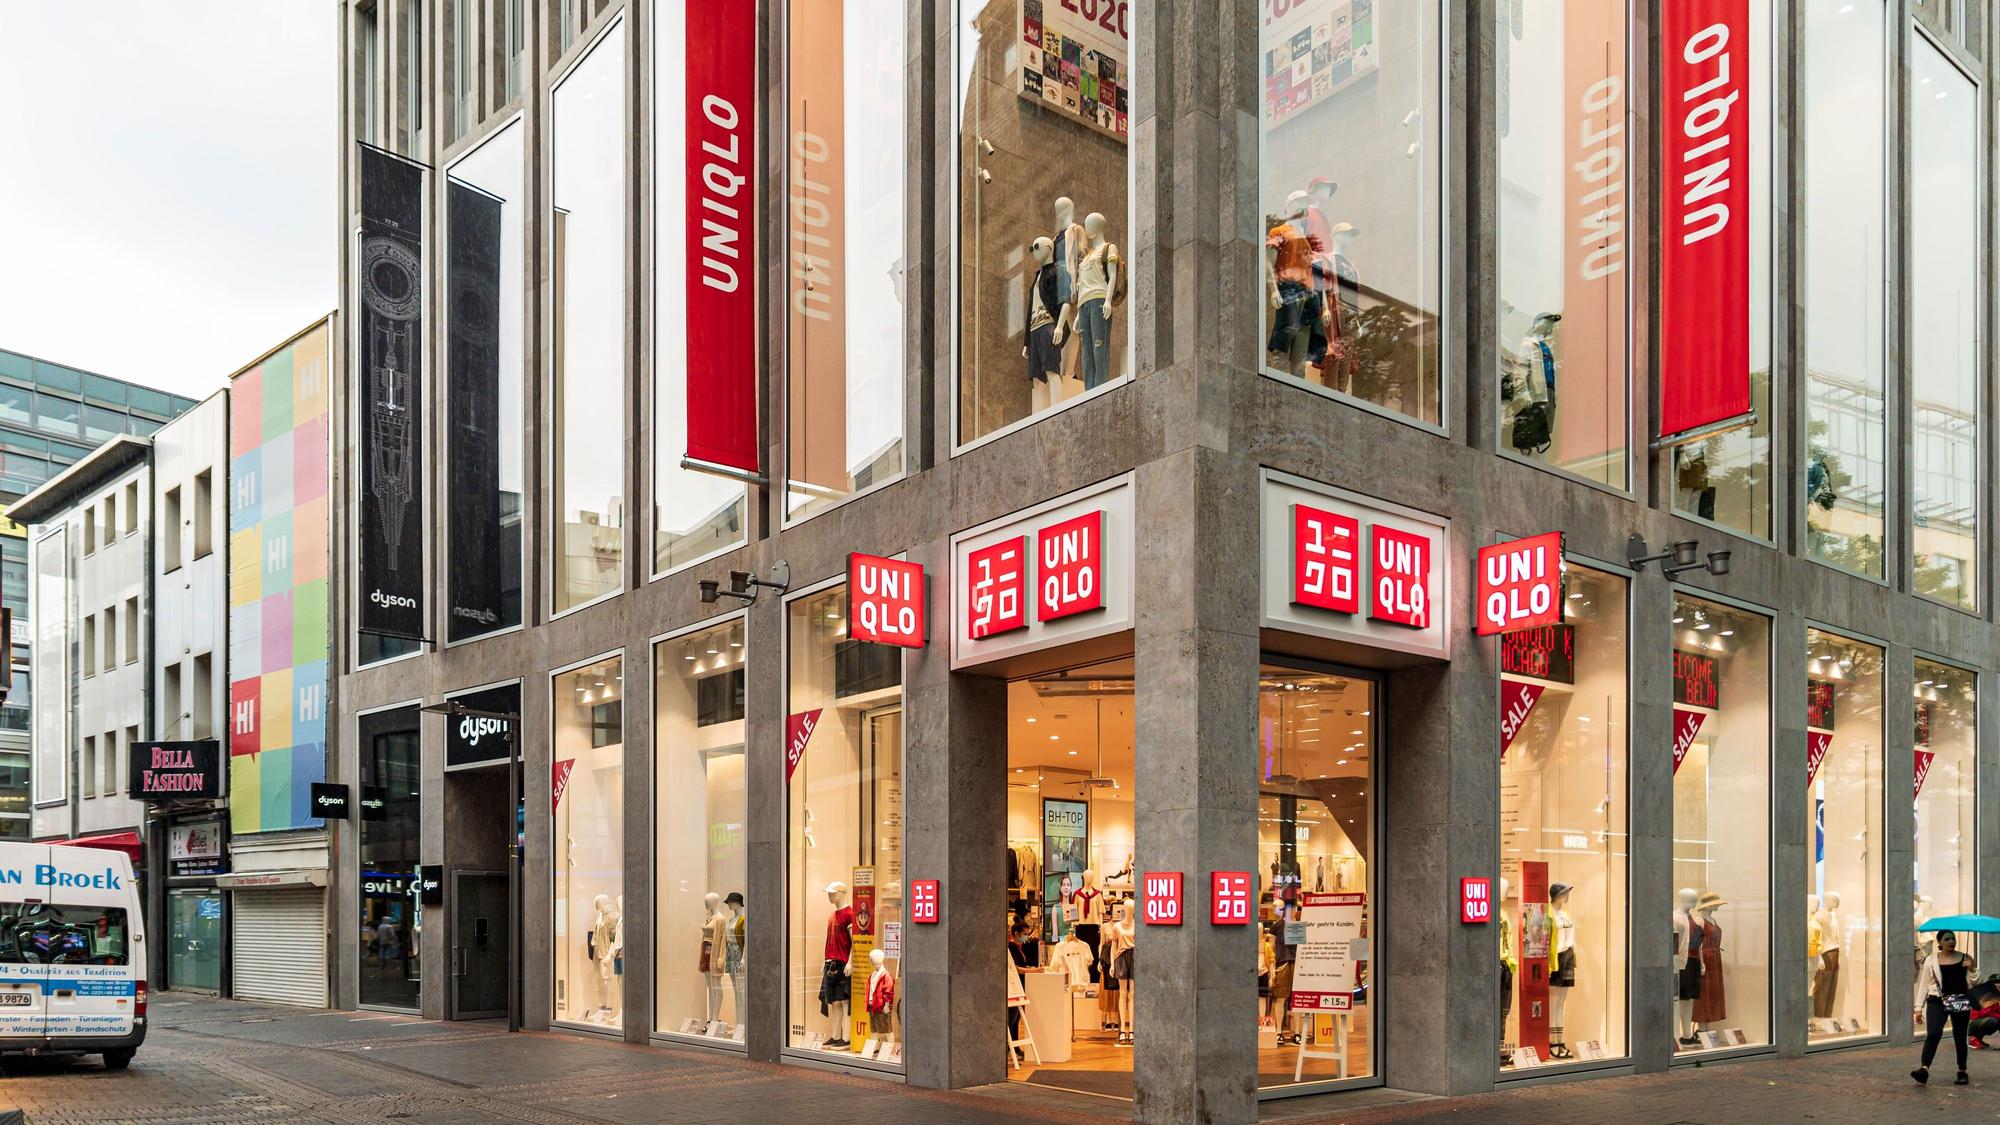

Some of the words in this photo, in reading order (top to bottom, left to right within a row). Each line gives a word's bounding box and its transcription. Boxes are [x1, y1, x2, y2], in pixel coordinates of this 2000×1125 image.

[1684, 23, 1739, 245] UNIQLO
[702, 94, 745, 293] UNIQLO
[300, 358, 320, 397] HI
[237, 471, 255, 509] HI
[267, 535, 286, 574] HI
[1044, 526, 1090, 569] UNI
[1304, 519, 1352, 561] ユニ
[1379, 537, 1421, 577] UNI
[859, 564, 910, 601] UNI
[976, 549, 1016, 590] ユニ
[1303, 560, 1352, 600] クロ
[1486, 546, 1545, 587] UNI
[371, 588, 416, 609] dyson
[975, 587, 1018, 628] クロ
[1044, 566, 1094, 612] QLO
[1379, 579, 1425, 616] QLO
[1486, 582, 1551, 627] QLO
[860, 601, 916, 636] QLO
[236, 699, 254, 735] HI
[299, 682, 320, 722] HI
[1501, 685, 1534, 741] SALE
[460, 715, 508, 746] dyson
[788, 713, 814, 766] SALE
[1673, 713, 1699, 762] SALE
[151, 747, 194, 769] BELLA
[1807, 735, 1828, 778] SALE
[1914, 753, 1930, 791] SALE
[143, 770, 204, 792] FASHION
[553, 762, 570, 801] SALE
[318, 795, 344, 806] dyson
[1048, 810, 1083, 823] BH-TOP
[423, 880, 438, 891] dyson
[1147, 879, 1175, 897] UNI
[1466, 883, 1486, 899] UNI
[1147, 899, 1177, 920] QLO
[1466, 901, 1488, 919] QLO
[5, 995, 29, 1004] 9876
[856, 1021, 867, 1036] UT
